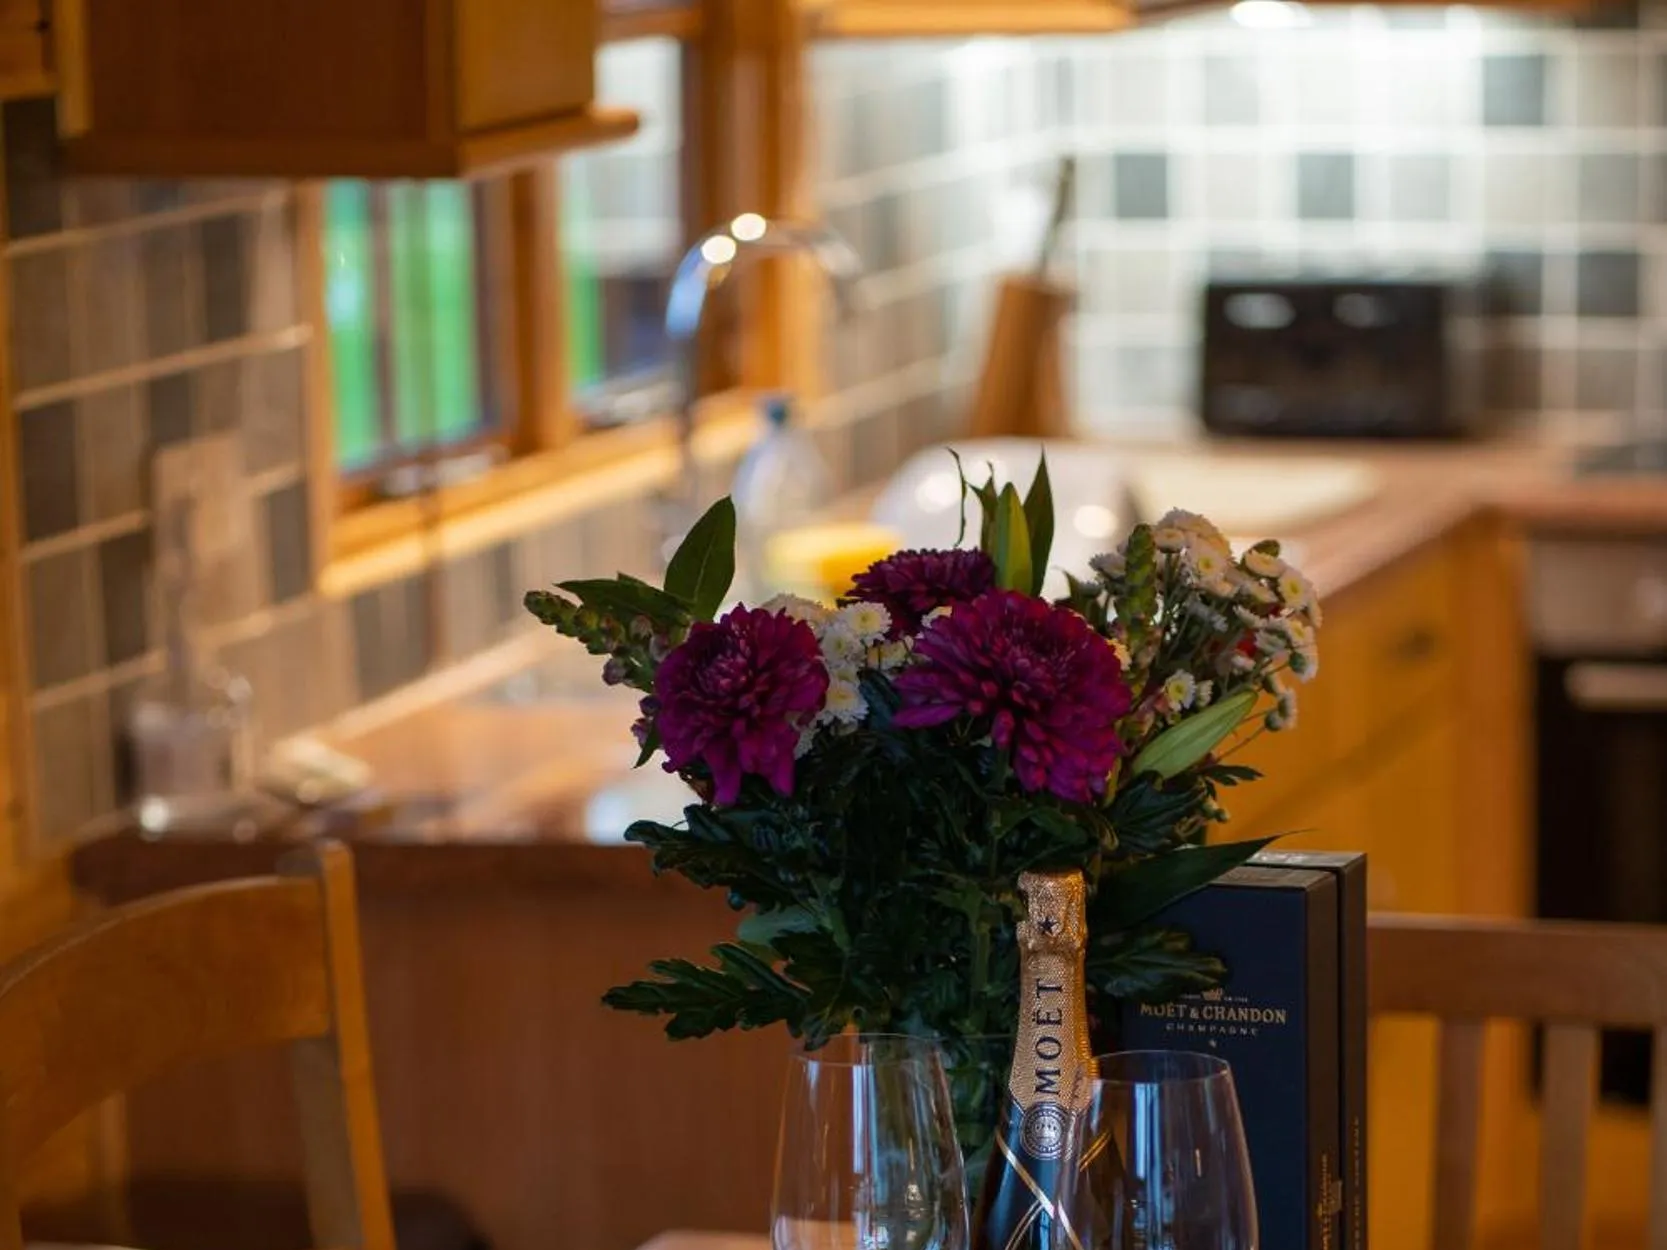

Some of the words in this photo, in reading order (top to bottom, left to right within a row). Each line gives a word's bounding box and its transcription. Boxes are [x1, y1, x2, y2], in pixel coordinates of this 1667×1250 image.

[1189, 1006, 1200, 1019] &
[1202, 1005, 1287, 1025] CHANDON
[1033, 978, 1063, 1097] MOËT
[1165, 1022, 1260, 1037] CHAMPAGNE
